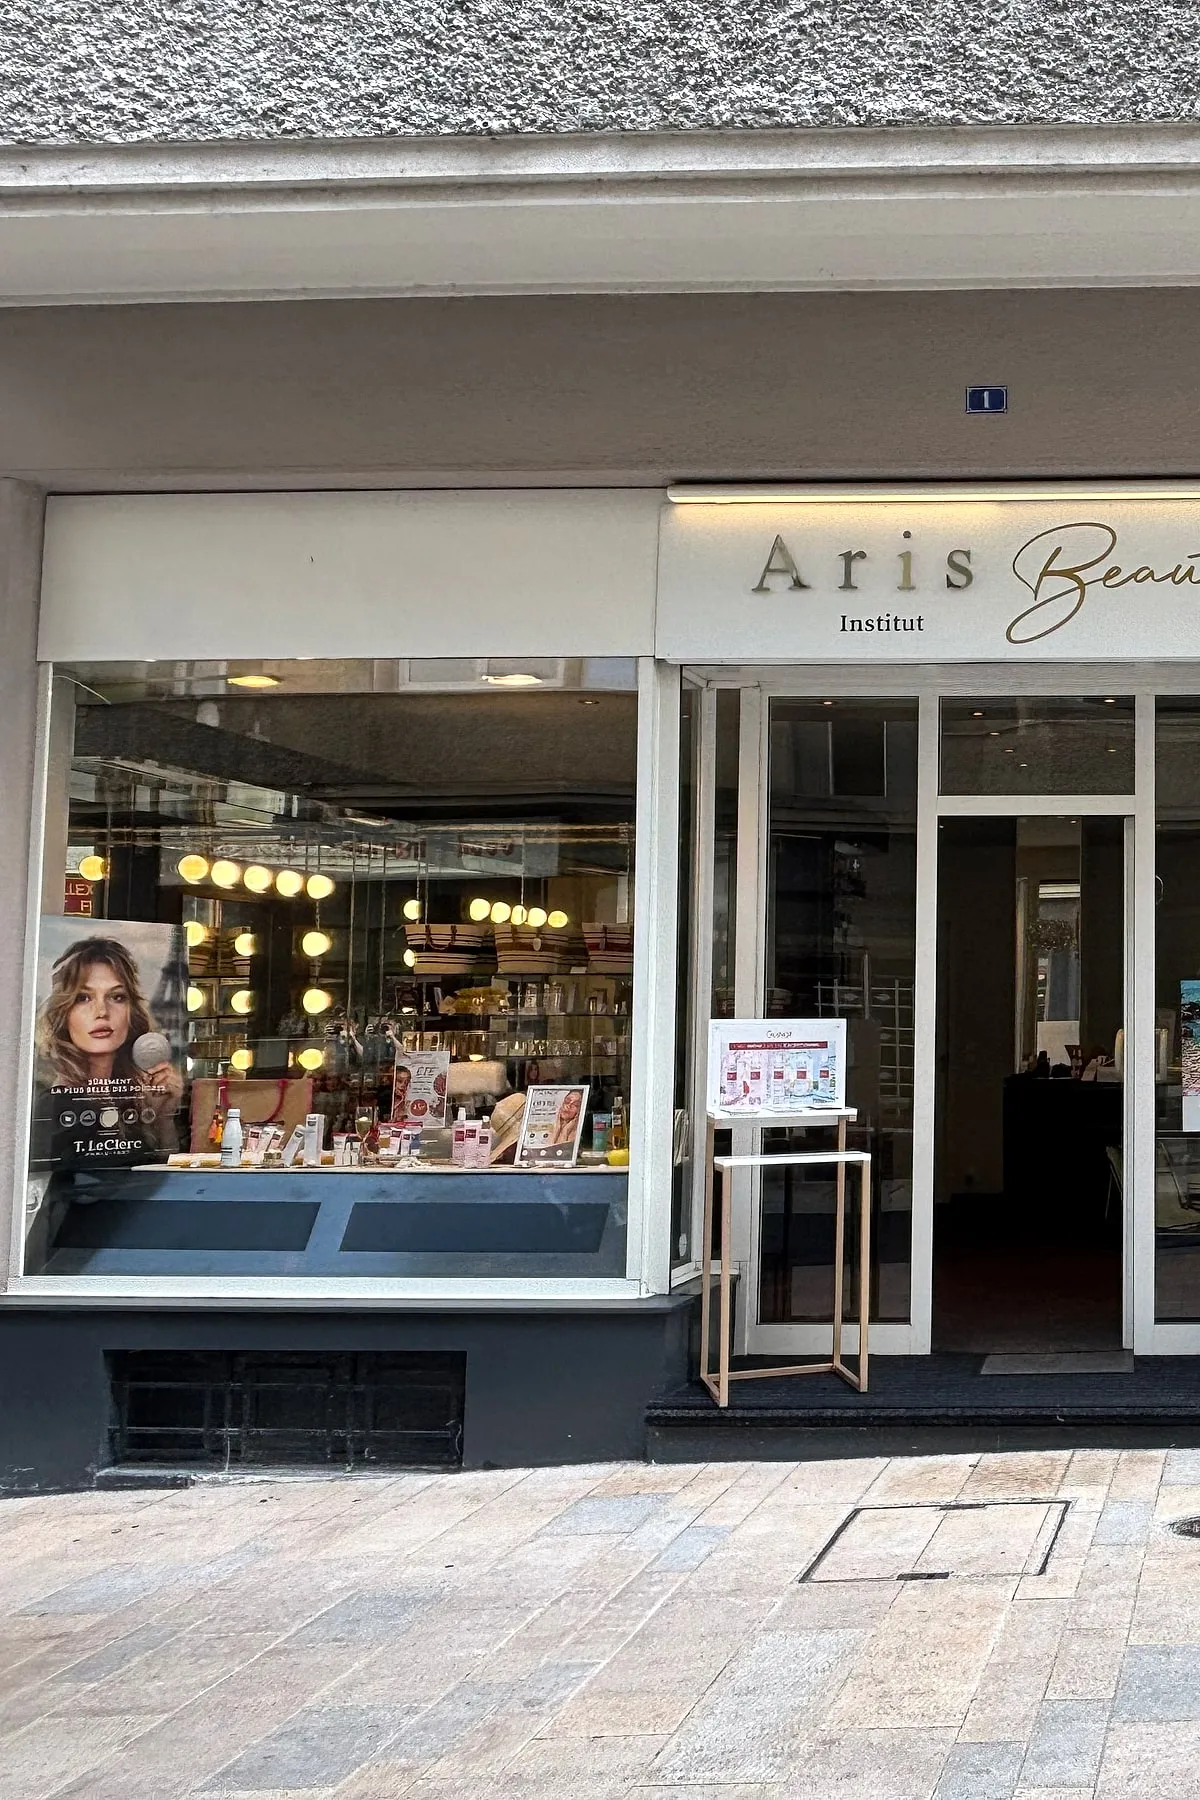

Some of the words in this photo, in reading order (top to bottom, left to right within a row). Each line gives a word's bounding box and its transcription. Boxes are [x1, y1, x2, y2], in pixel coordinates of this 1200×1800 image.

[751, 530, 974, 592] Aris
[839, 614, 924, 632] Institut
[88, 1139, 142, 1151] LeClerc
